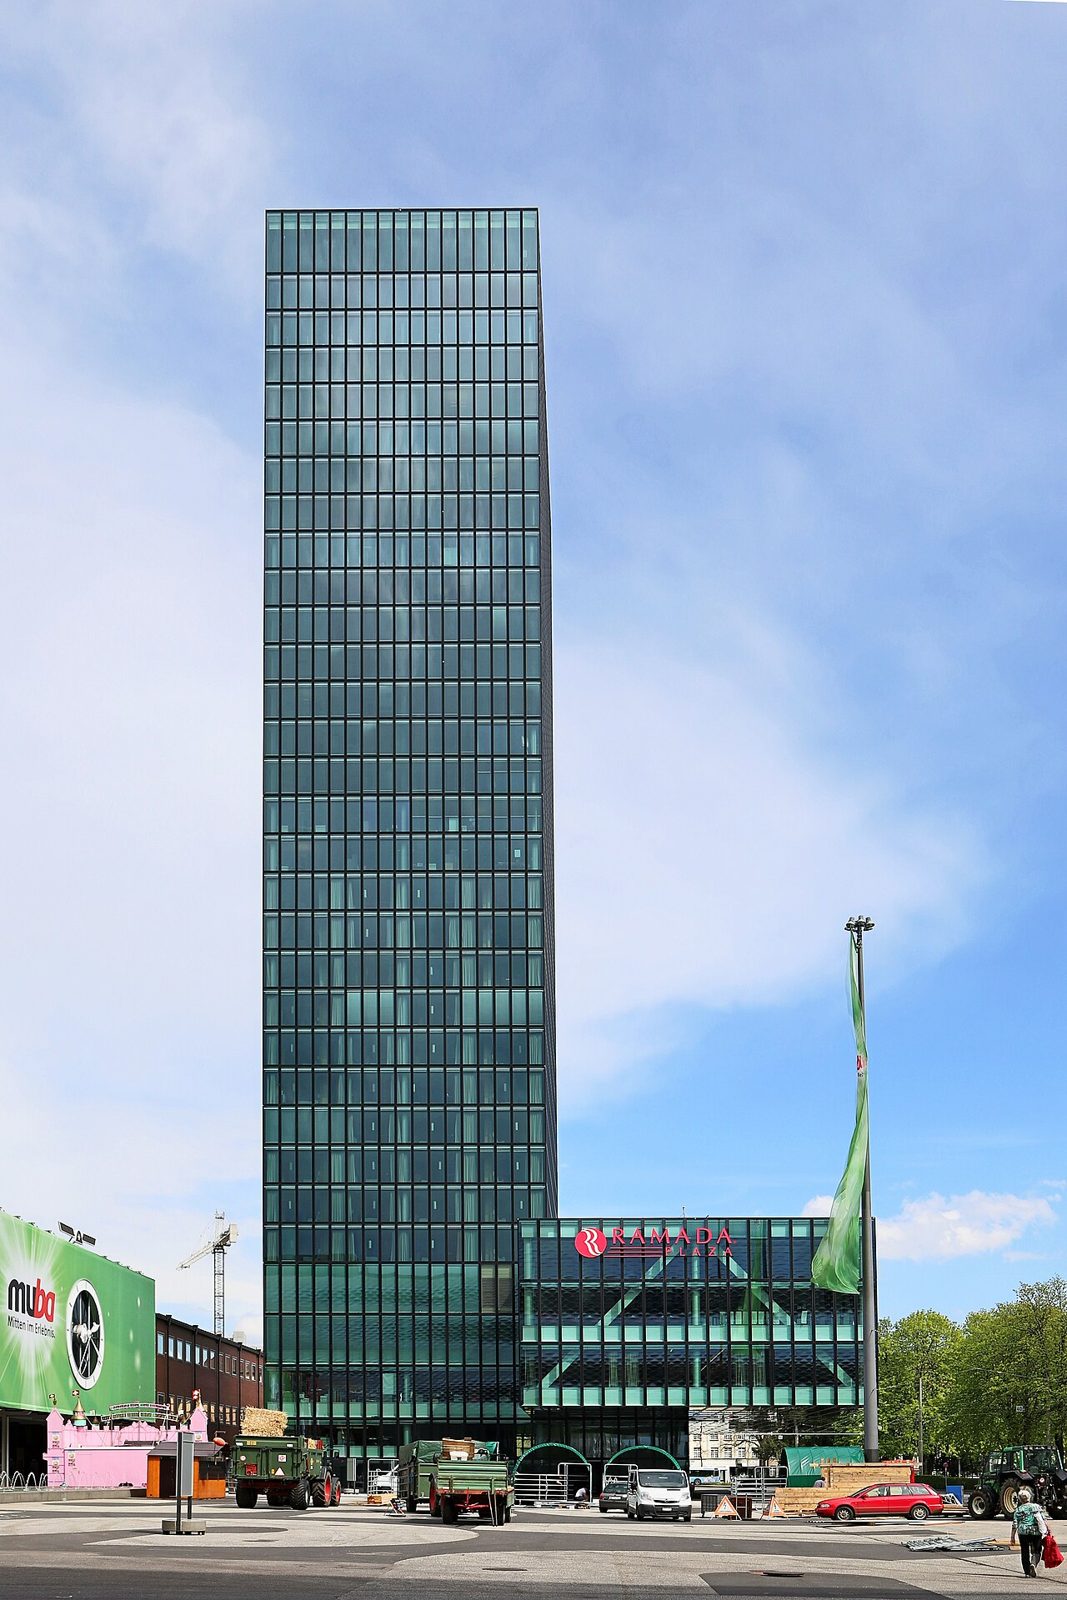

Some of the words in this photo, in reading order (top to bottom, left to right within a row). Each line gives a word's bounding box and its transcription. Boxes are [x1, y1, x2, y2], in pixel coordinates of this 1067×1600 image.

[612, 1227, 733, 1245] RAMADA
[665, 1246, 733, 1257] PLAZA
[8, 1278, 55, 1322] muba
[7, 1315, 26, 1330] Mitten
[27, 1320, 34, 1332] im
